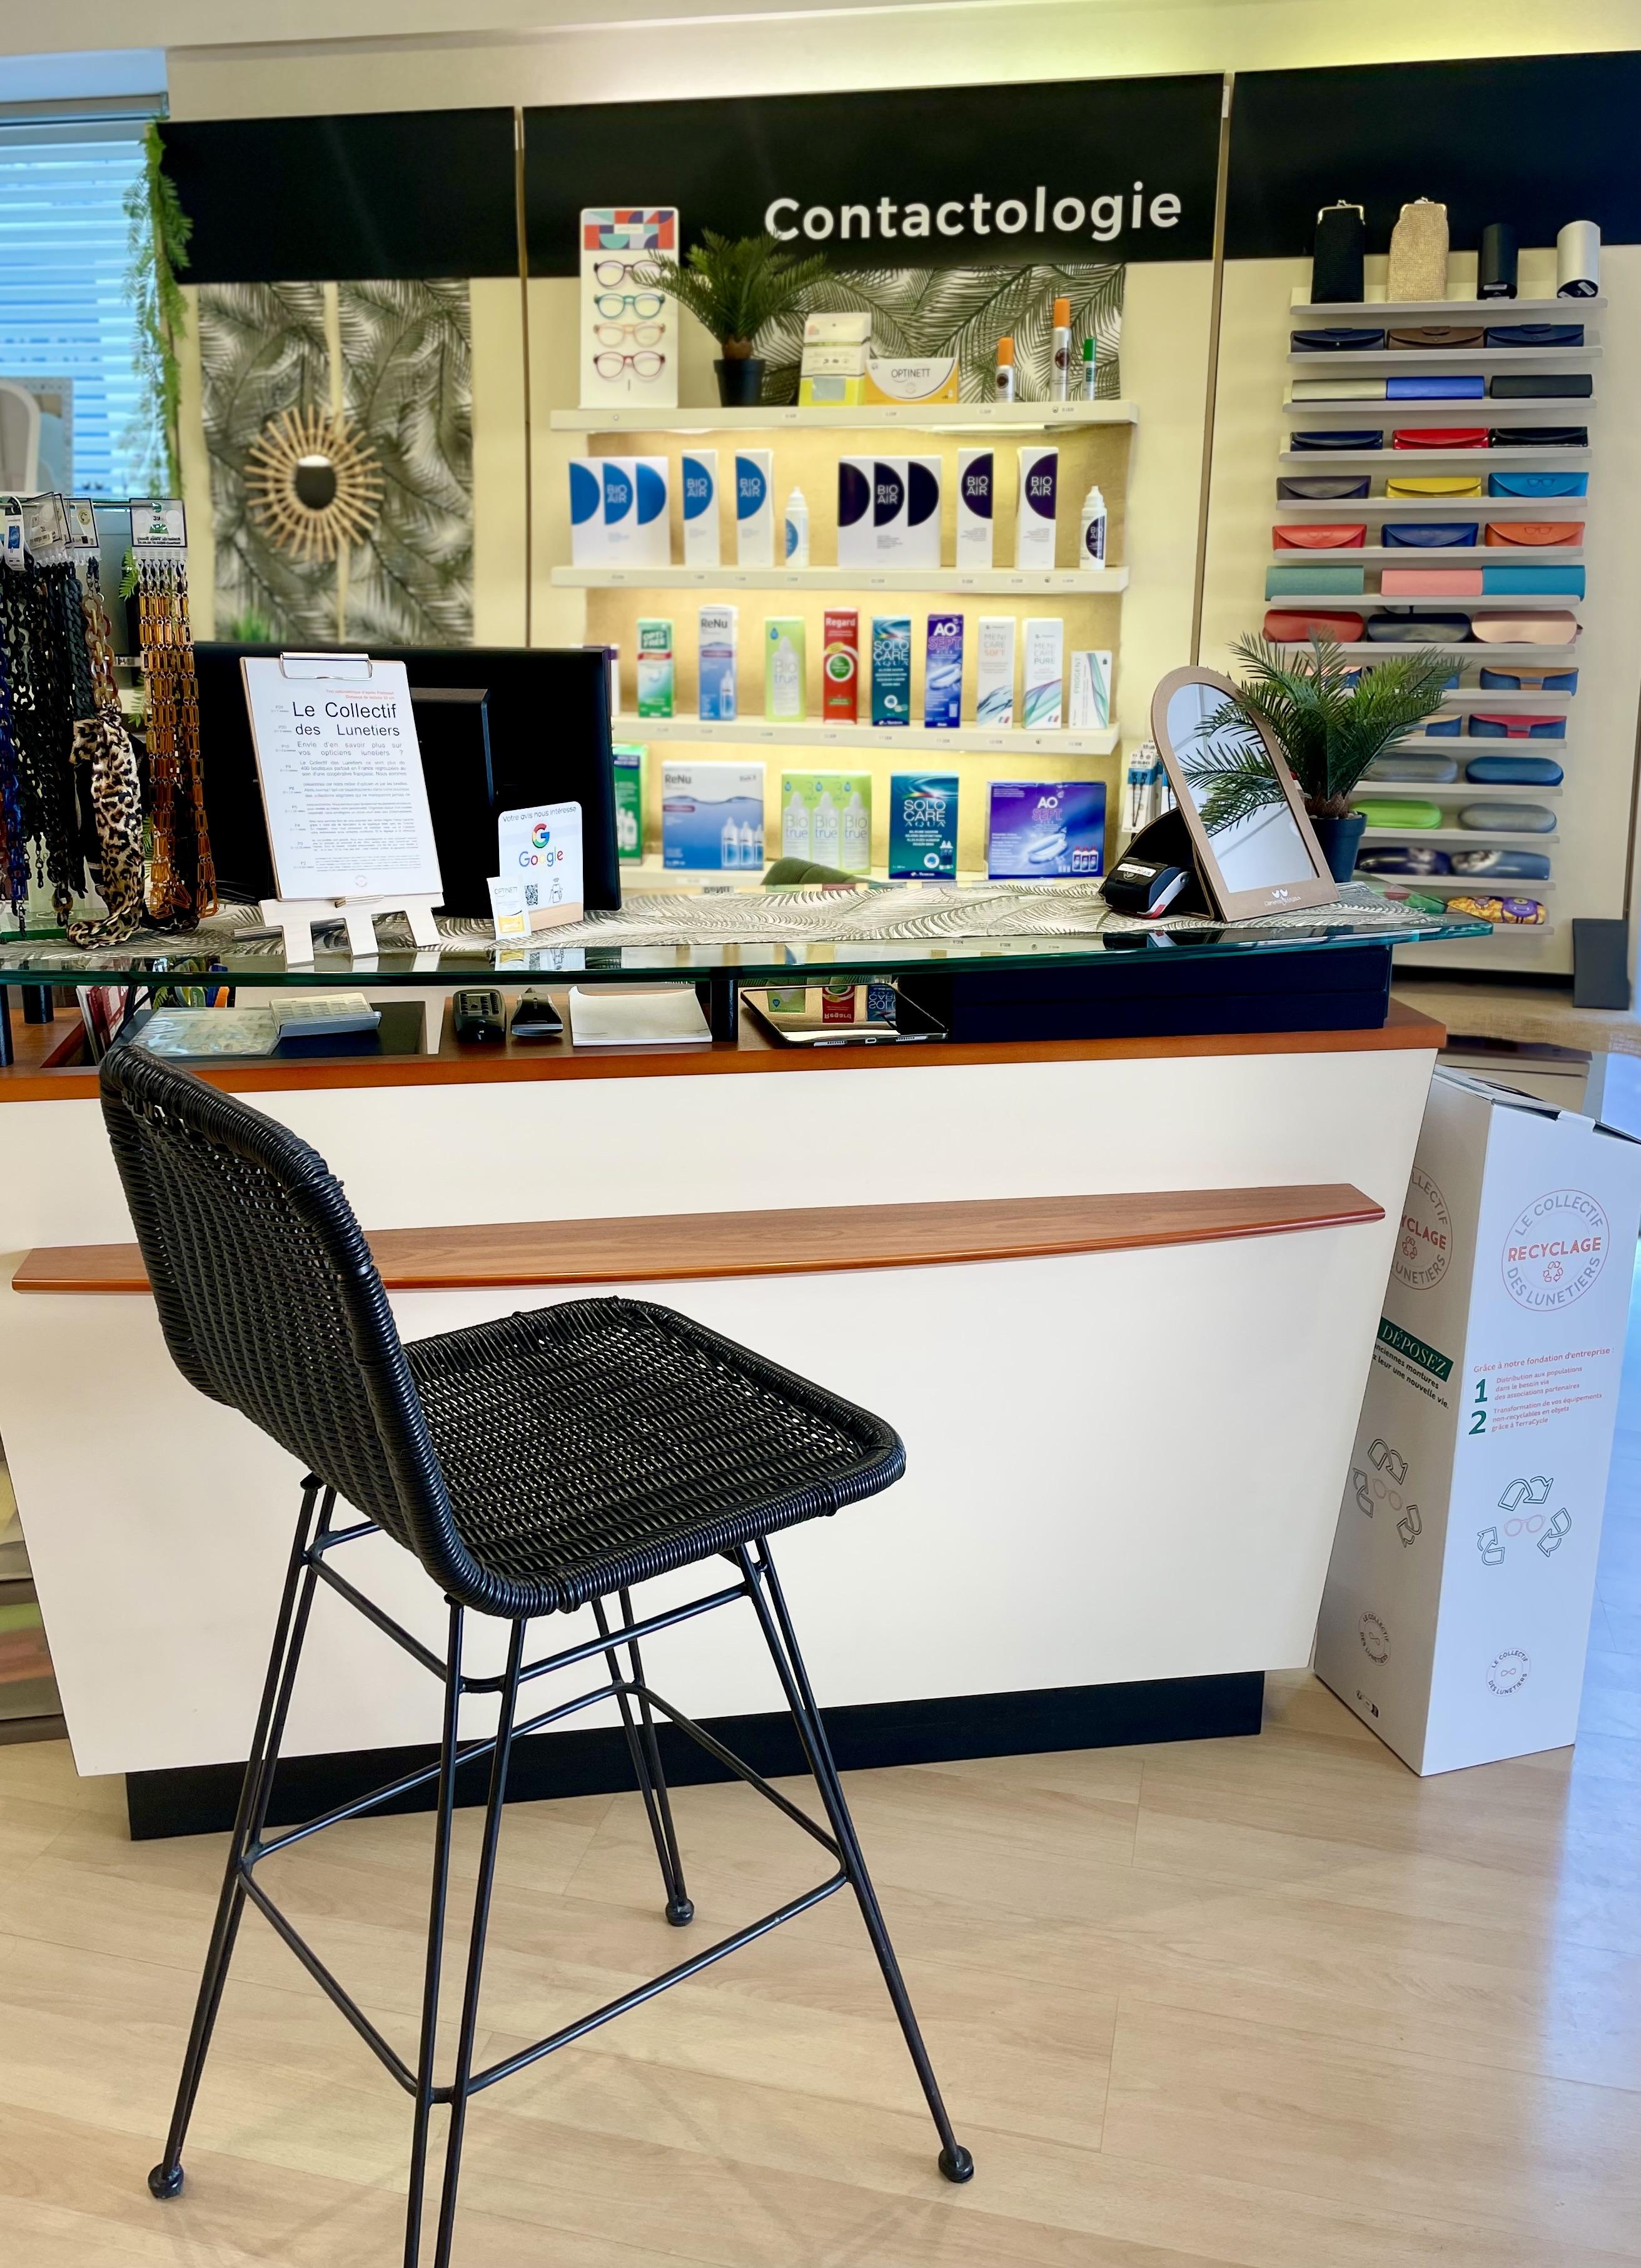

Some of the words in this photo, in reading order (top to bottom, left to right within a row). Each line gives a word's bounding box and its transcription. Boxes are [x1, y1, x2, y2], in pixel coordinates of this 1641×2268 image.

[765, 181, 1181, 241] Contactologie
[891, 368, 931, 378] OPTINETT
[687, 478, 707, 488] BIO
[740, 478, 760, 488] BIO
[967, 476, 988, 486] BIO
[1031, 476, 1053, 486] BIO
[607, 485, 627, 494] BIO
[687, 488, 707, 497] AIR
[740, 488, 759, 497] AIR
[877, 485, 899, 495] BIO
[966, 487, 987, 495] AIR
[1031, 487, 1052, 495] AIR
[607, 494, 627, 504] AIR
[877, 495, 898, 504] AIR
[701, 619, 728, 629] ReNu
[826, 617, 856, 628] Regard
[934, 623, 957, 636] AO
[874, 640, 909, 651] SOLO
[928, 636, 962, 650] SEPT
[873, 651, 909, 661] CARE
[293, 701, 315, 717] Le
[325, 702, 396, 718] Collectif
[296, 724, 320, 735] des
[337, 724, 400, 736] Lunetiers
[665, 774, 692, 784] ReNu
[904, 800, 946, 811] SOLO
[1038, 797, 1058, 809] AO
[550, 806, 577, 815] intéresse
[904, 811, 946, 821] CARE
[1032, 808, 1062, 821] SEPT
[786, 829, 808, 838] true
[815, 829, 837, 838] true
[845, 829, 867, 838] true
[519, 846, 563, 867] Google
[1411, 1172, 1448, 1225] LLECTIF
[1515, 1215, 1533, 1236] LE
[1534, 1195, 1603, 1227] COLLECTIF
[1508, 1237, 1602, 1262] RECYCLAGE
[1395, 1254, 1445, 1283] UNETIERS
[1507, 1267, 1527, 1296] DES
[1526, 1257, 1600, 1305] LUNETIERS
[1382, 1325, 1447, 1376] DÉPOSEZ
[1473, 1364, 1496, 1373] Grâce
[1498, 1361, 1502, 1369] à
[1504, 1360, 1525, 1369] notre
[1527, 1354, 1563, 1366] fondation
[1565, 1348, 1610, 1360] d'entreprise
[1406, 1364, 1439, 1389] montures
[1497, 1374, 1533, 1384] Distribution
[1547, 1366, 1582, 1377] populations
[1378, 1356, 1391, 1369] leur
[1393, 1367, 1405, 1379] une
[1406, 1377, 1436, 1400] nouvelle
[1438, 1396, 1449, 1409] vie.
[1519, 1380, 1538, 1389] besoin
[1475, 1379, 1488, 1403] 1
[1507, 1389, 1543, 1399] associations
[1545, 1384, 1580, 1394] partenaires
[1493, 1402, 1541, 1414] Transformation
[1563, 1393, 1602, 1404] équipements
[1492, 1411, 1541, 1422] non-recyclables
[1468, 1410, 1487, 1435] 2
[1492, 1424, 1509, 1432] grâce
[1516, 1417, 1548, 1427] TerraCycle
[1491, 1660, 1498, 1668] LE
[1499, 1651, 1528, 1662] COLLECTIF
[1488, 1680, 1497, 1691] DES
[1497, 1673, 1527, 1694] LUNETIERS
